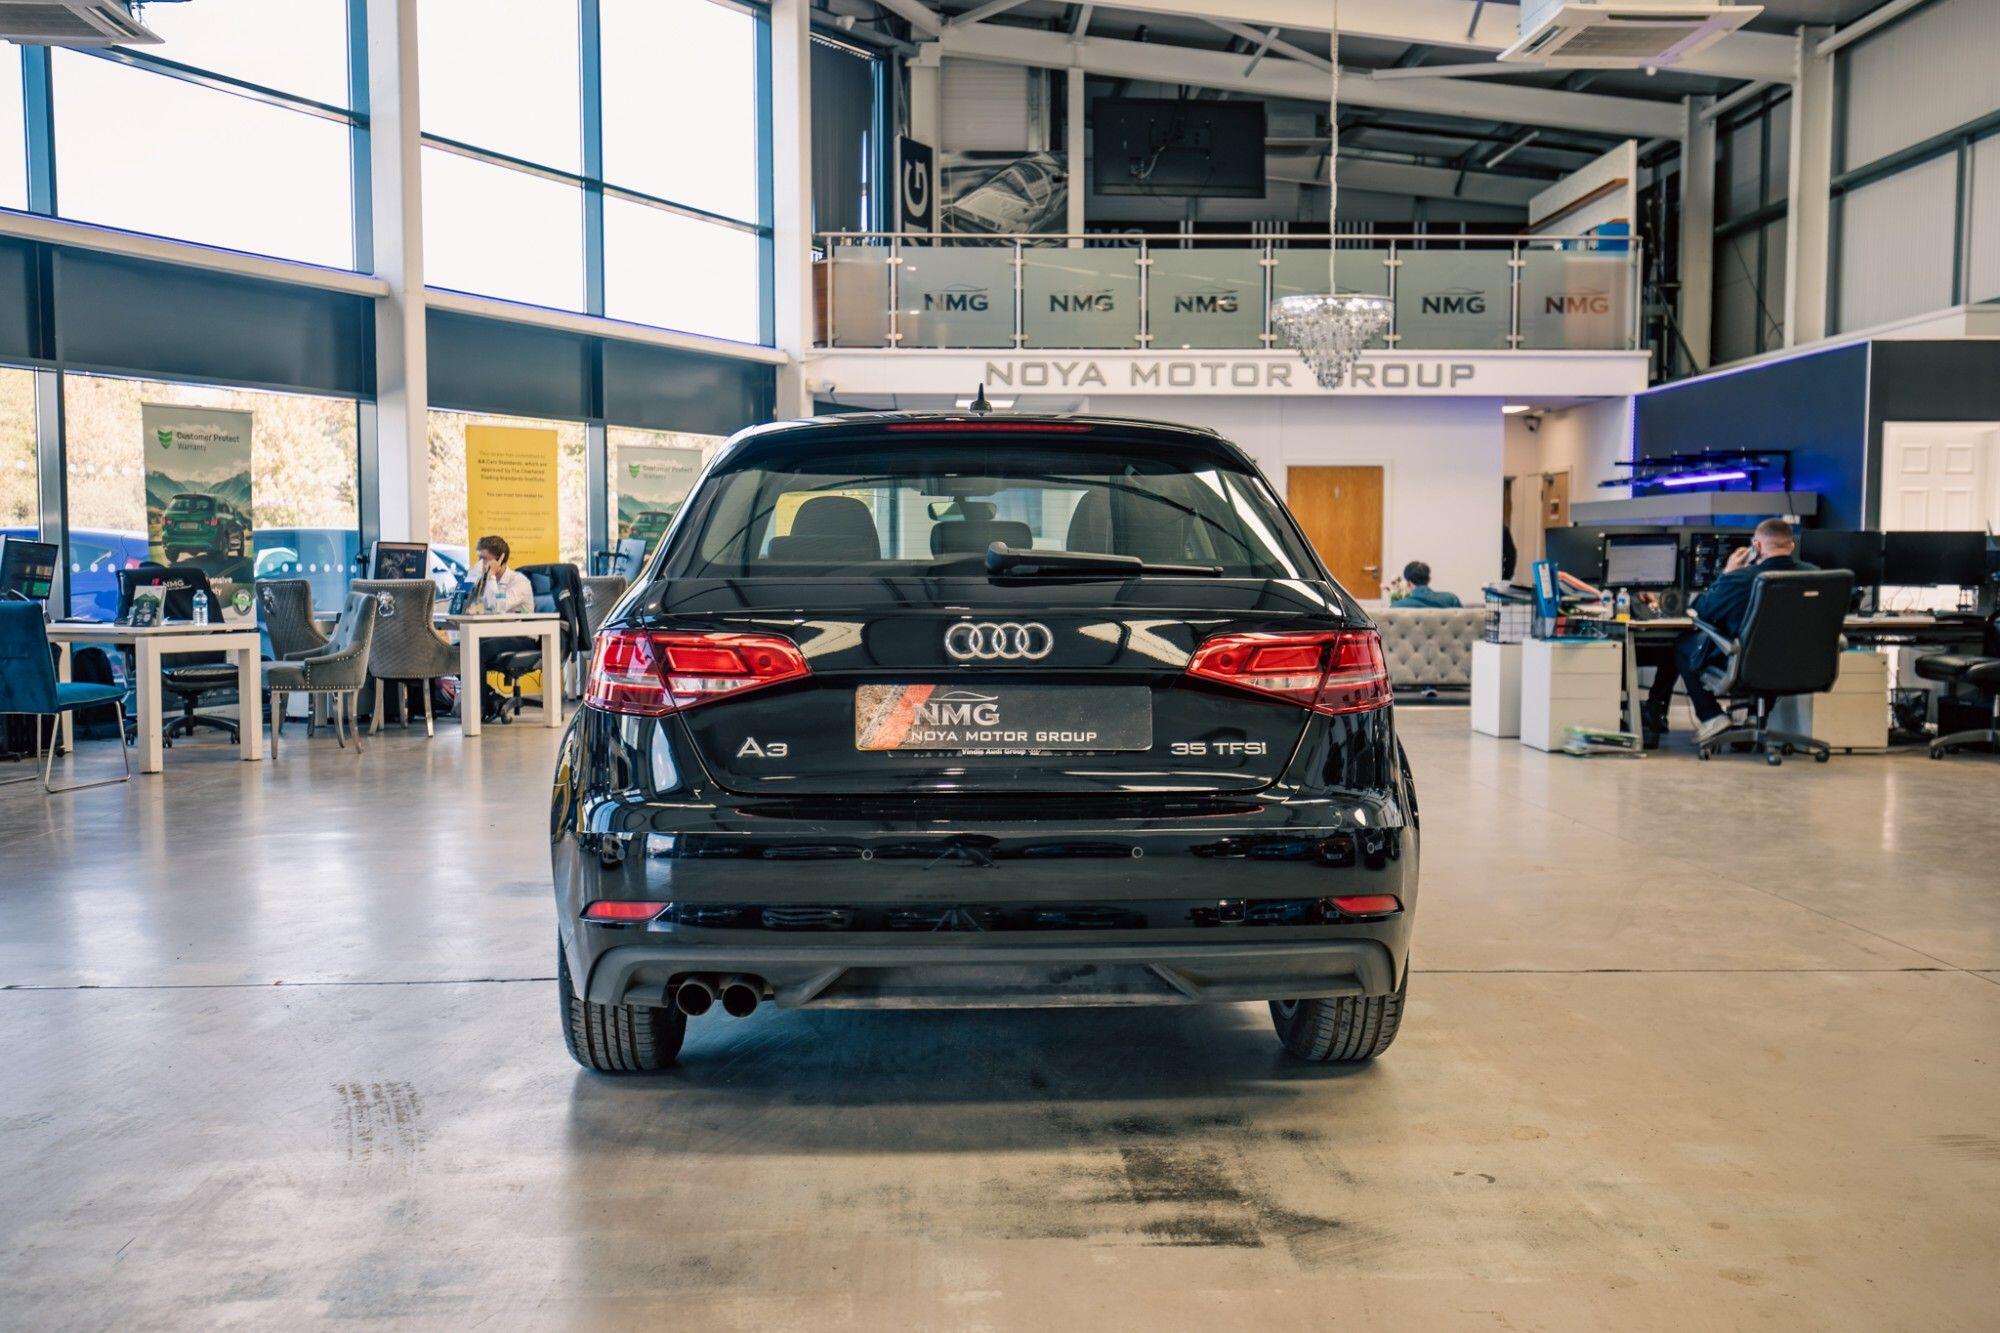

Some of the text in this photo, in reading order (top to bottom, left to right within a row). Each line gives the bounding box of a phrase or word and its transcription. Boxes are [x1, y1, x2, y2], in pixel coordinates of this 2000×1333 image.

[924, 293, 989, 312] NMG
[1050, 294, 1114, 313] NMG
[1174, 296, 1239, 314] NMG
[1422, 296, 1486, 314] NMG
[1545, 296, 1610, 314] NMG
[986, 361, 1107, 386] NOYA
[1131, 361, 1293, 388] MOTOR
[176, 432, 240, 443] Customer Protect
[177, 443, 207, 453] Warranty
[162, 579, 185, 588] NMG
[914, 703, 1000, 726] NMG
[911, 731, 1098, 743] NOYA MOTOR GROUP
[737, 737, 788, 757] A3
[1171, 742, 1267, 756] 35 TFSI
